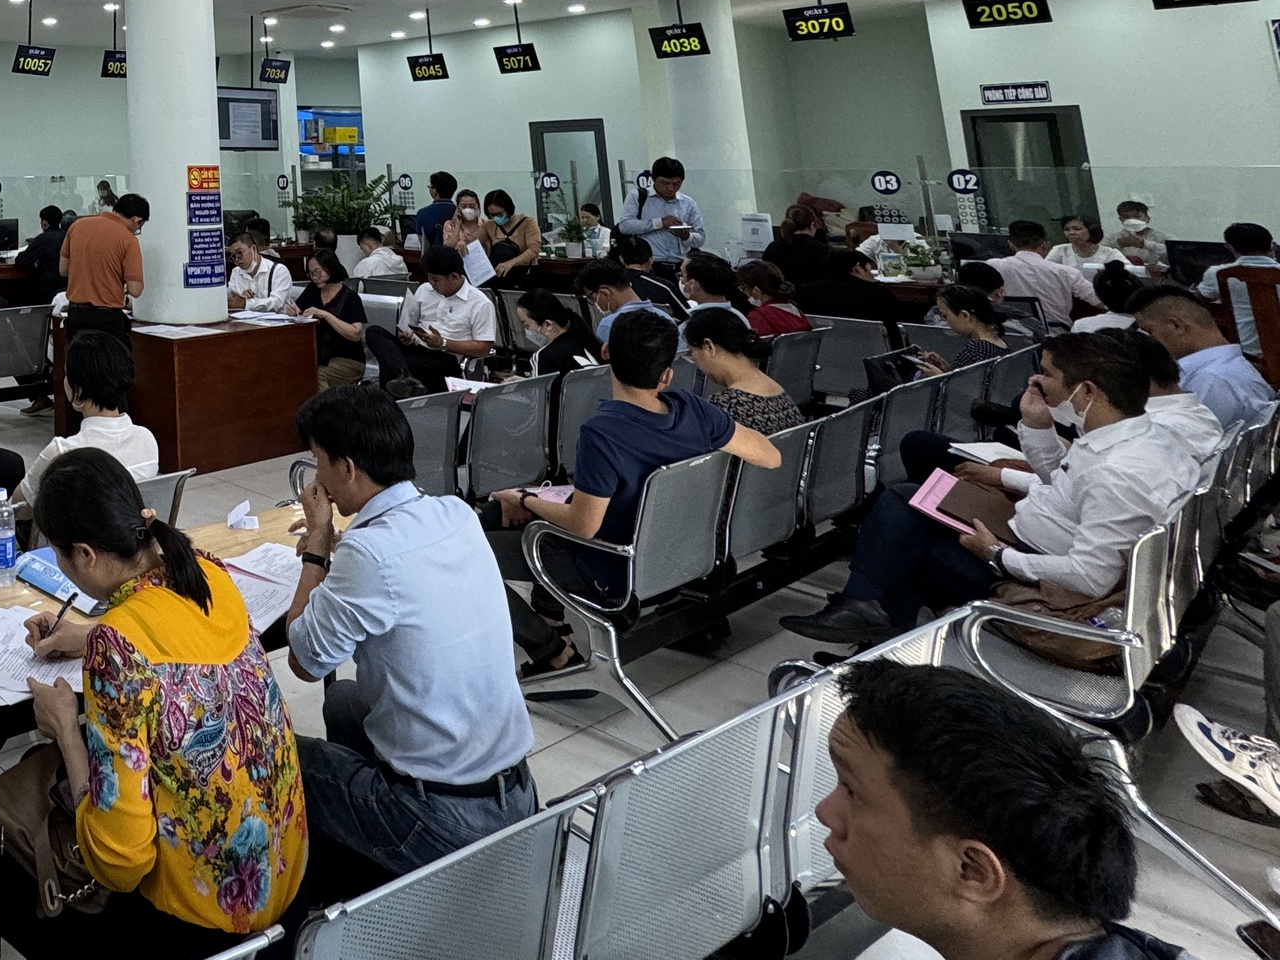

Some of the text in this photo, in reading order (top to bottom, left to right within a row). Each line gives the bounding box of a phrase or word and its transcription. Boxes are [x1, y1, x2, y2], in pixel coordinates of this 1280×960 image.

[803, 8, 823, 17] QUẦY
[976, 1, 1038, 22] 2050
[665, 28, 682, 36] QUẦY
[795, 17, 845, 35] 3070
[661, 37, 702, 54] 4038
[18, 57, 52, 73] 10057
[107, 61, 127, 75] 903
[502, 55, 533, 70] 5071
[264, 68, 286, 80] 7034
[415, 64, 443, 78] 6045
[984, 85, 1048, 102] PHÒNG TIẾP CÔNG DÂN
[279, 177, 287, 188] 07
[400, 177, 411, 187] 06
[543, 176, 558, 189] 05
[874, 175, 898, 191] 03
[952, 174, 978, 190] 02
